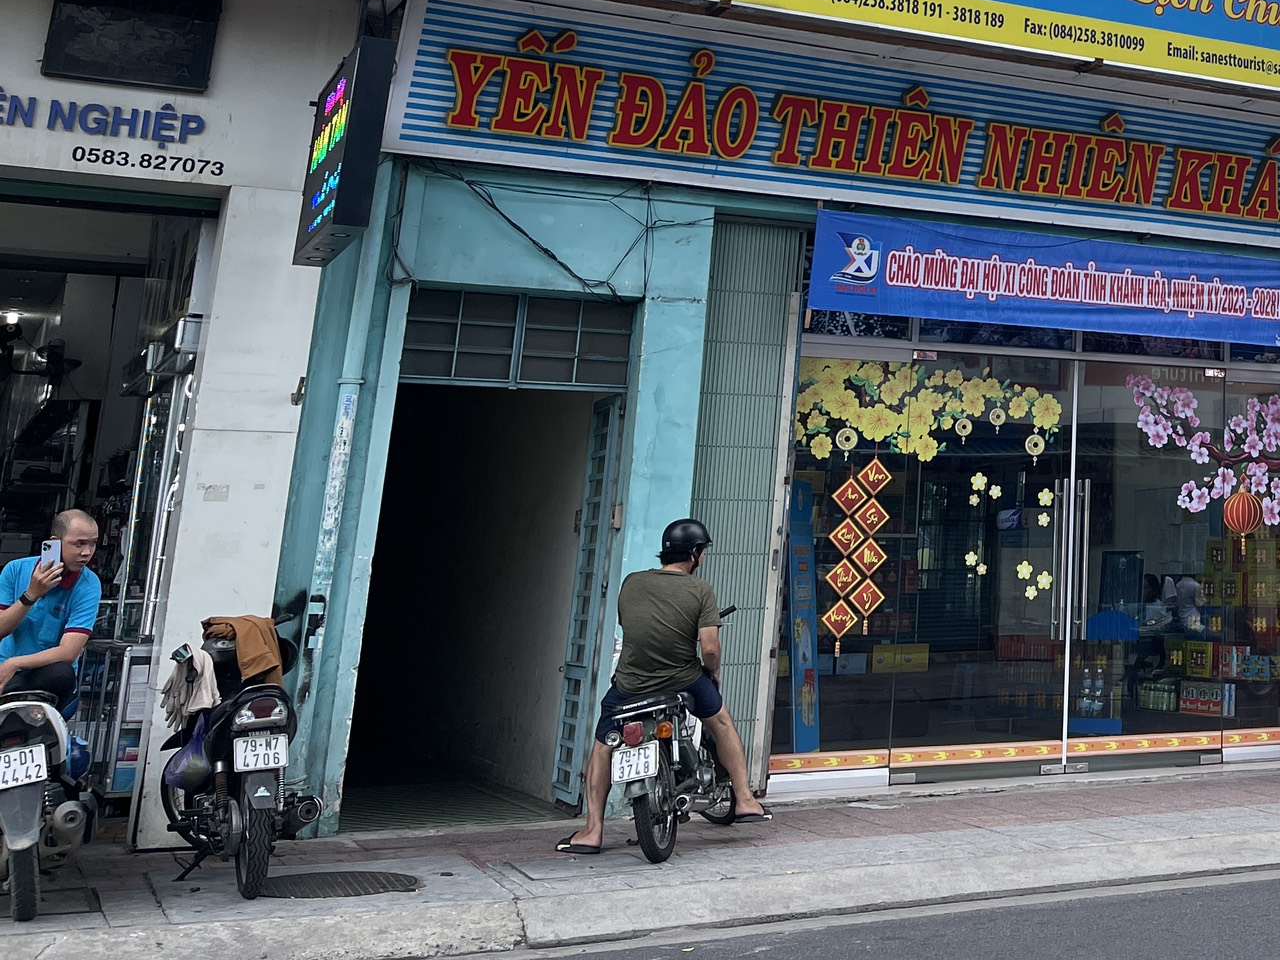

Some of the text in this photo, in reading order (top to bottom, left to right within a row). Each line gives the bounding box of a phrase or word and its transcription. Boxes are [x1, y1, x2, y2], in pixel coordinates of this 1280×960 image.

[922, 0, 943, 19] 191
[952, 5, 981, 26] 3818
[983, 11, 1005, 29] 189
[1023, 18, 1047, 37] Fax:
[1049, 22, 1146, 52] (084)258.3810099
[1167, 41, 1199, 64] Email:
[47, 103, 206, 149] NGHIỆP
[446, 27, 605, 142] YẾN
[607, 49, 760, 161] ĐẢO
[771, 85, 976, 186] THIÊN
[977, 110, 1168, 207] NHIÊN
[72, 146, 224, 177] 0583.827073
[887, 246, 922, 288] CHÀO
[921, 249, 959, 291] MỪNG
[959, 256, 981, 299] ĐẠI
[981, 254, 1003, 302] HỘI
[1003, 261, 1017, 294] XI
[1018, 258, 1050, 299] CÔNG
[1050, 263, 1082, 302] ĐOÀN
[1082, 260, 1108, 305] TỈNH
[1108, 268, 1146, 308] KHÁNH
[1146, 270, 1171, 313] HÒA,
[1171, 274, 1207, 319] NHIỆM
[1207, 277, 1221, 314] KỲ
[1221, 287, 1246, 316] 2023
[242, 753, 281, 768] 4706
[619, 761, 650, 779] 3748
